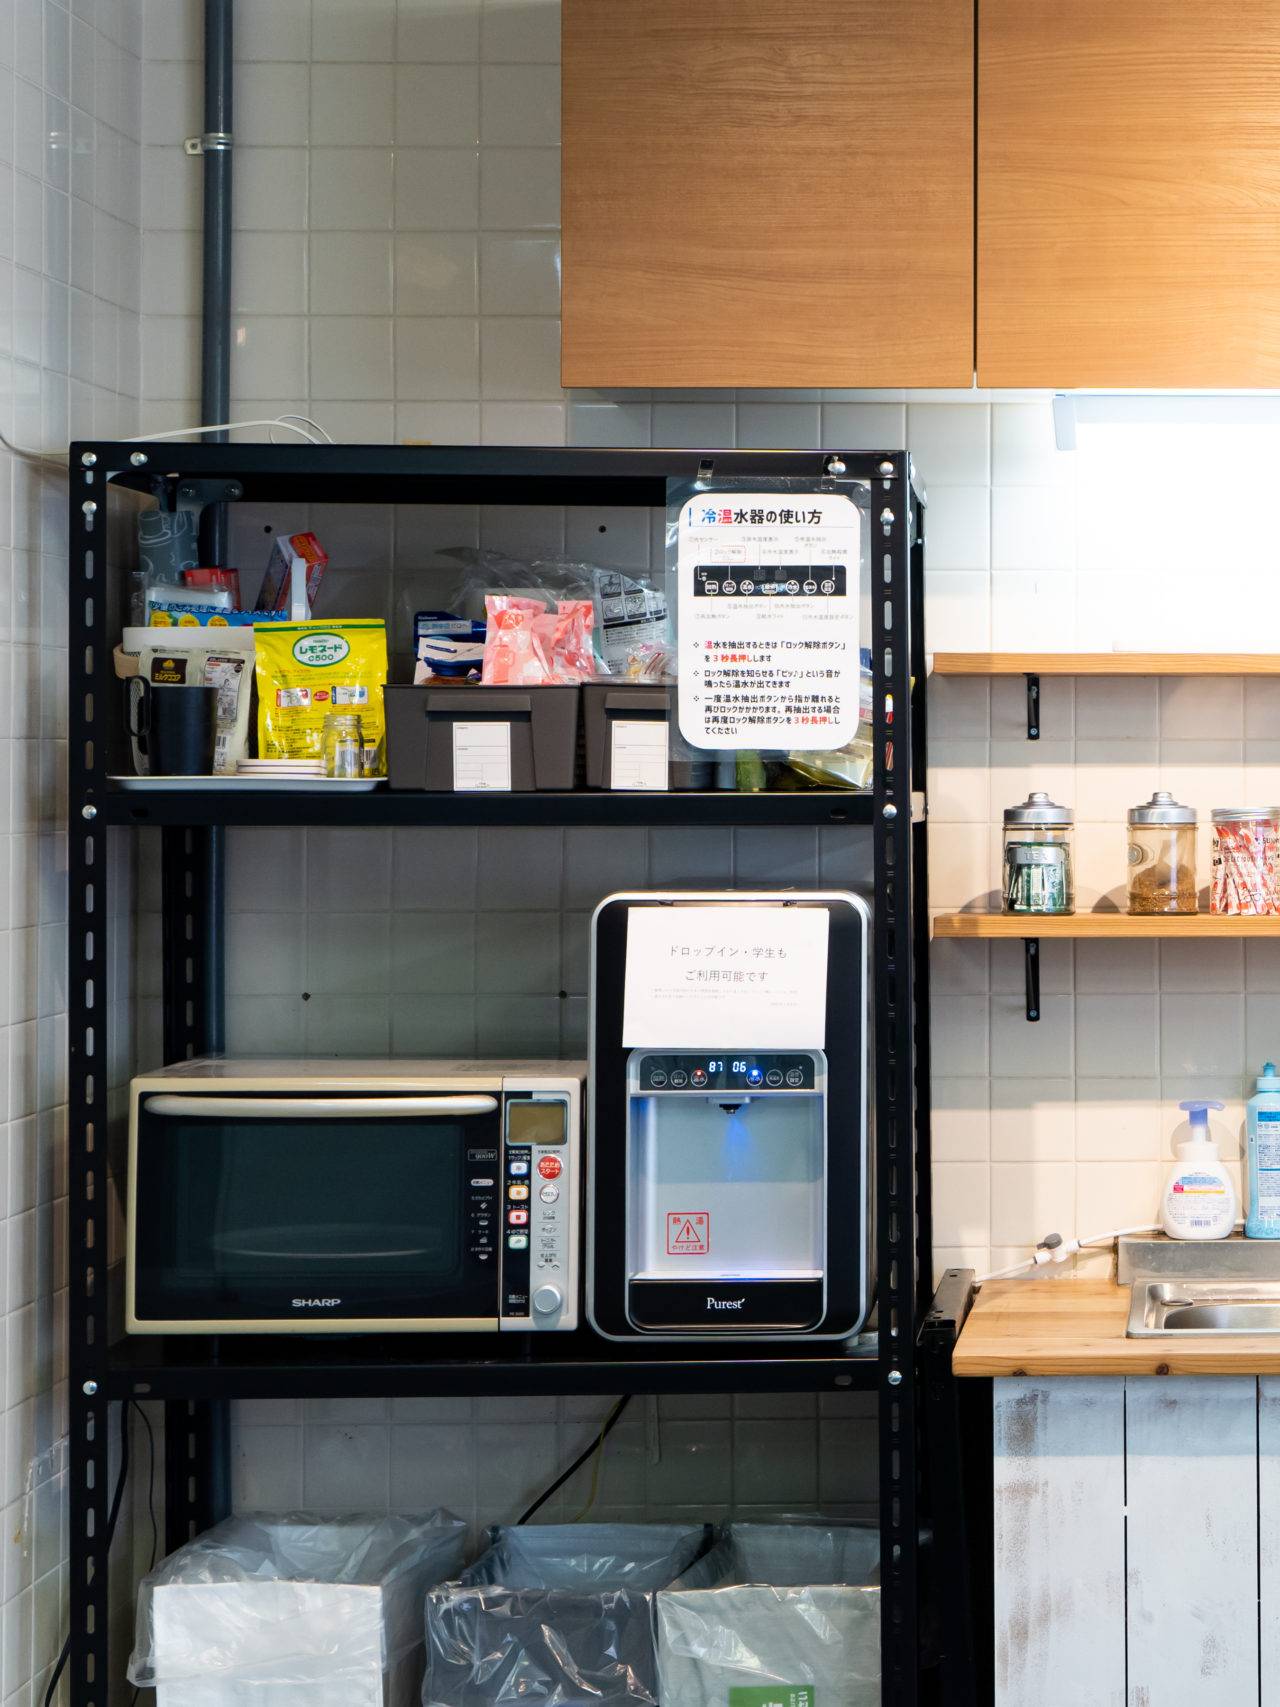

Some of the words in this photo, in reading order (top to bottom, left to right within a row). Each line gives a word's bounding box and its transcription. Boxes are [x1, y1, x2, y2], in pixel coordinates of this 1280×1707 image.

[701, 508, 823, 525] 冷温水器の使い方
[299, 644, 343, 655] レモネード
[704, 640, 846, 650] 温水を抽出するときは「ロック解除ボタン」
[308, 654, 334, 662] C500
[704, 680, 791, 689] 鳴ったら温水が出てきます
[704, 694, 841, 704] 一度温水抽出ボタンから指が離れると
[704, 727, 738, 735] てください
[1024, 852, 1048, 861] TEA
[669, 944, 787, 959] ドロップイン・学生も
[685, 968, 769, 982] ご利用可能です
[708, 1061, 724, 1073] 87
[732, 1061, 747, 1073] 06
[291, 1297, 342, 1307] SHARP
[706, 1296, 746, 1310] Purest
